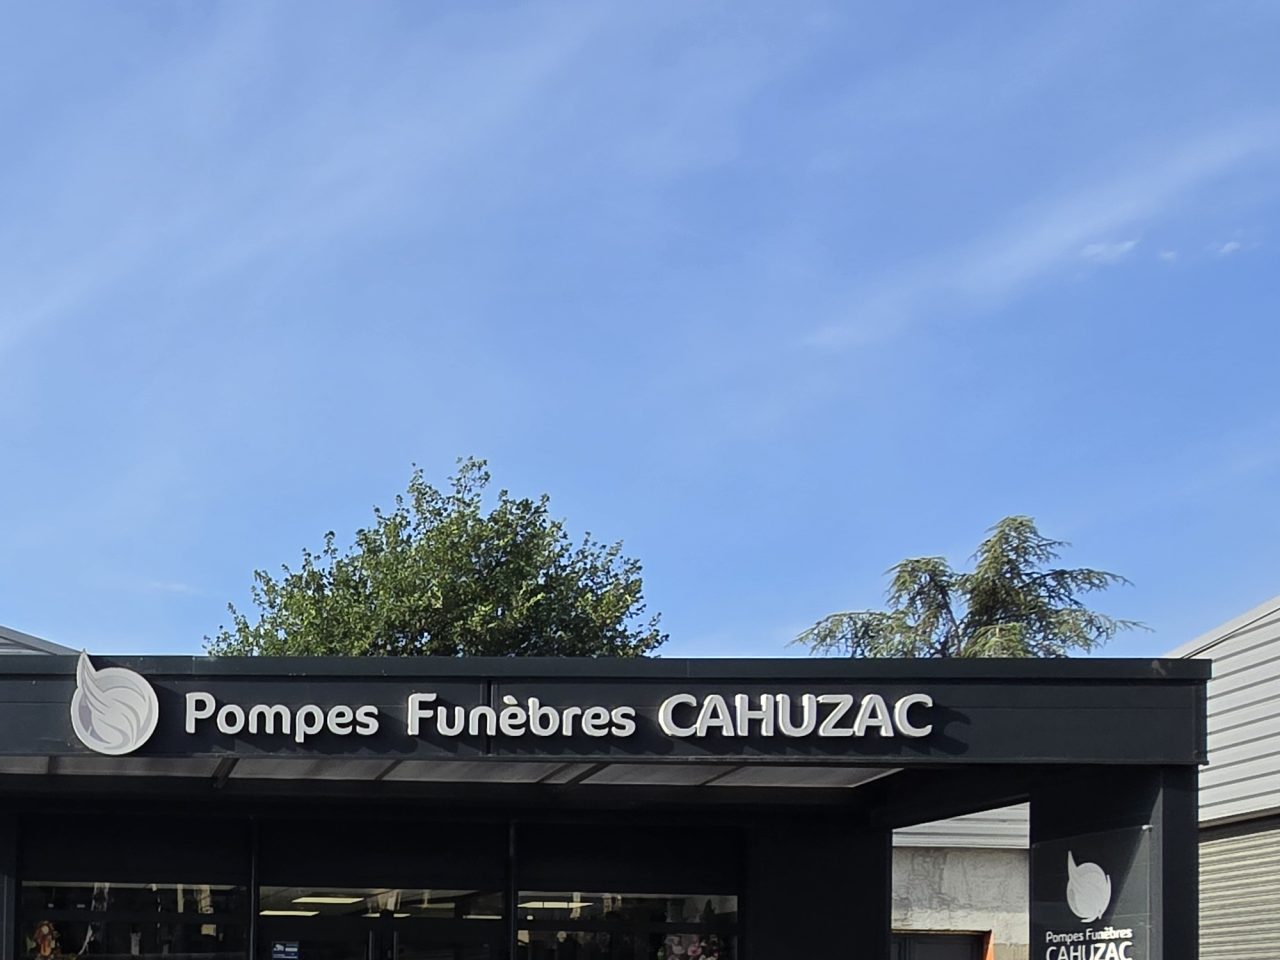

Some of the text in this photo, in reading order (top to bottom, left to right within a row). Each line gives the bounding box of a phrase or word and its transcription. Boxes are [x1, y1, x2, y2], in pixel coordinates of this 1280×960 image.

[185, 692, 933, 743] Pompes Funèbres CAHUZAC
[1046, 926, 1133, 945] Pompes Funèbres
